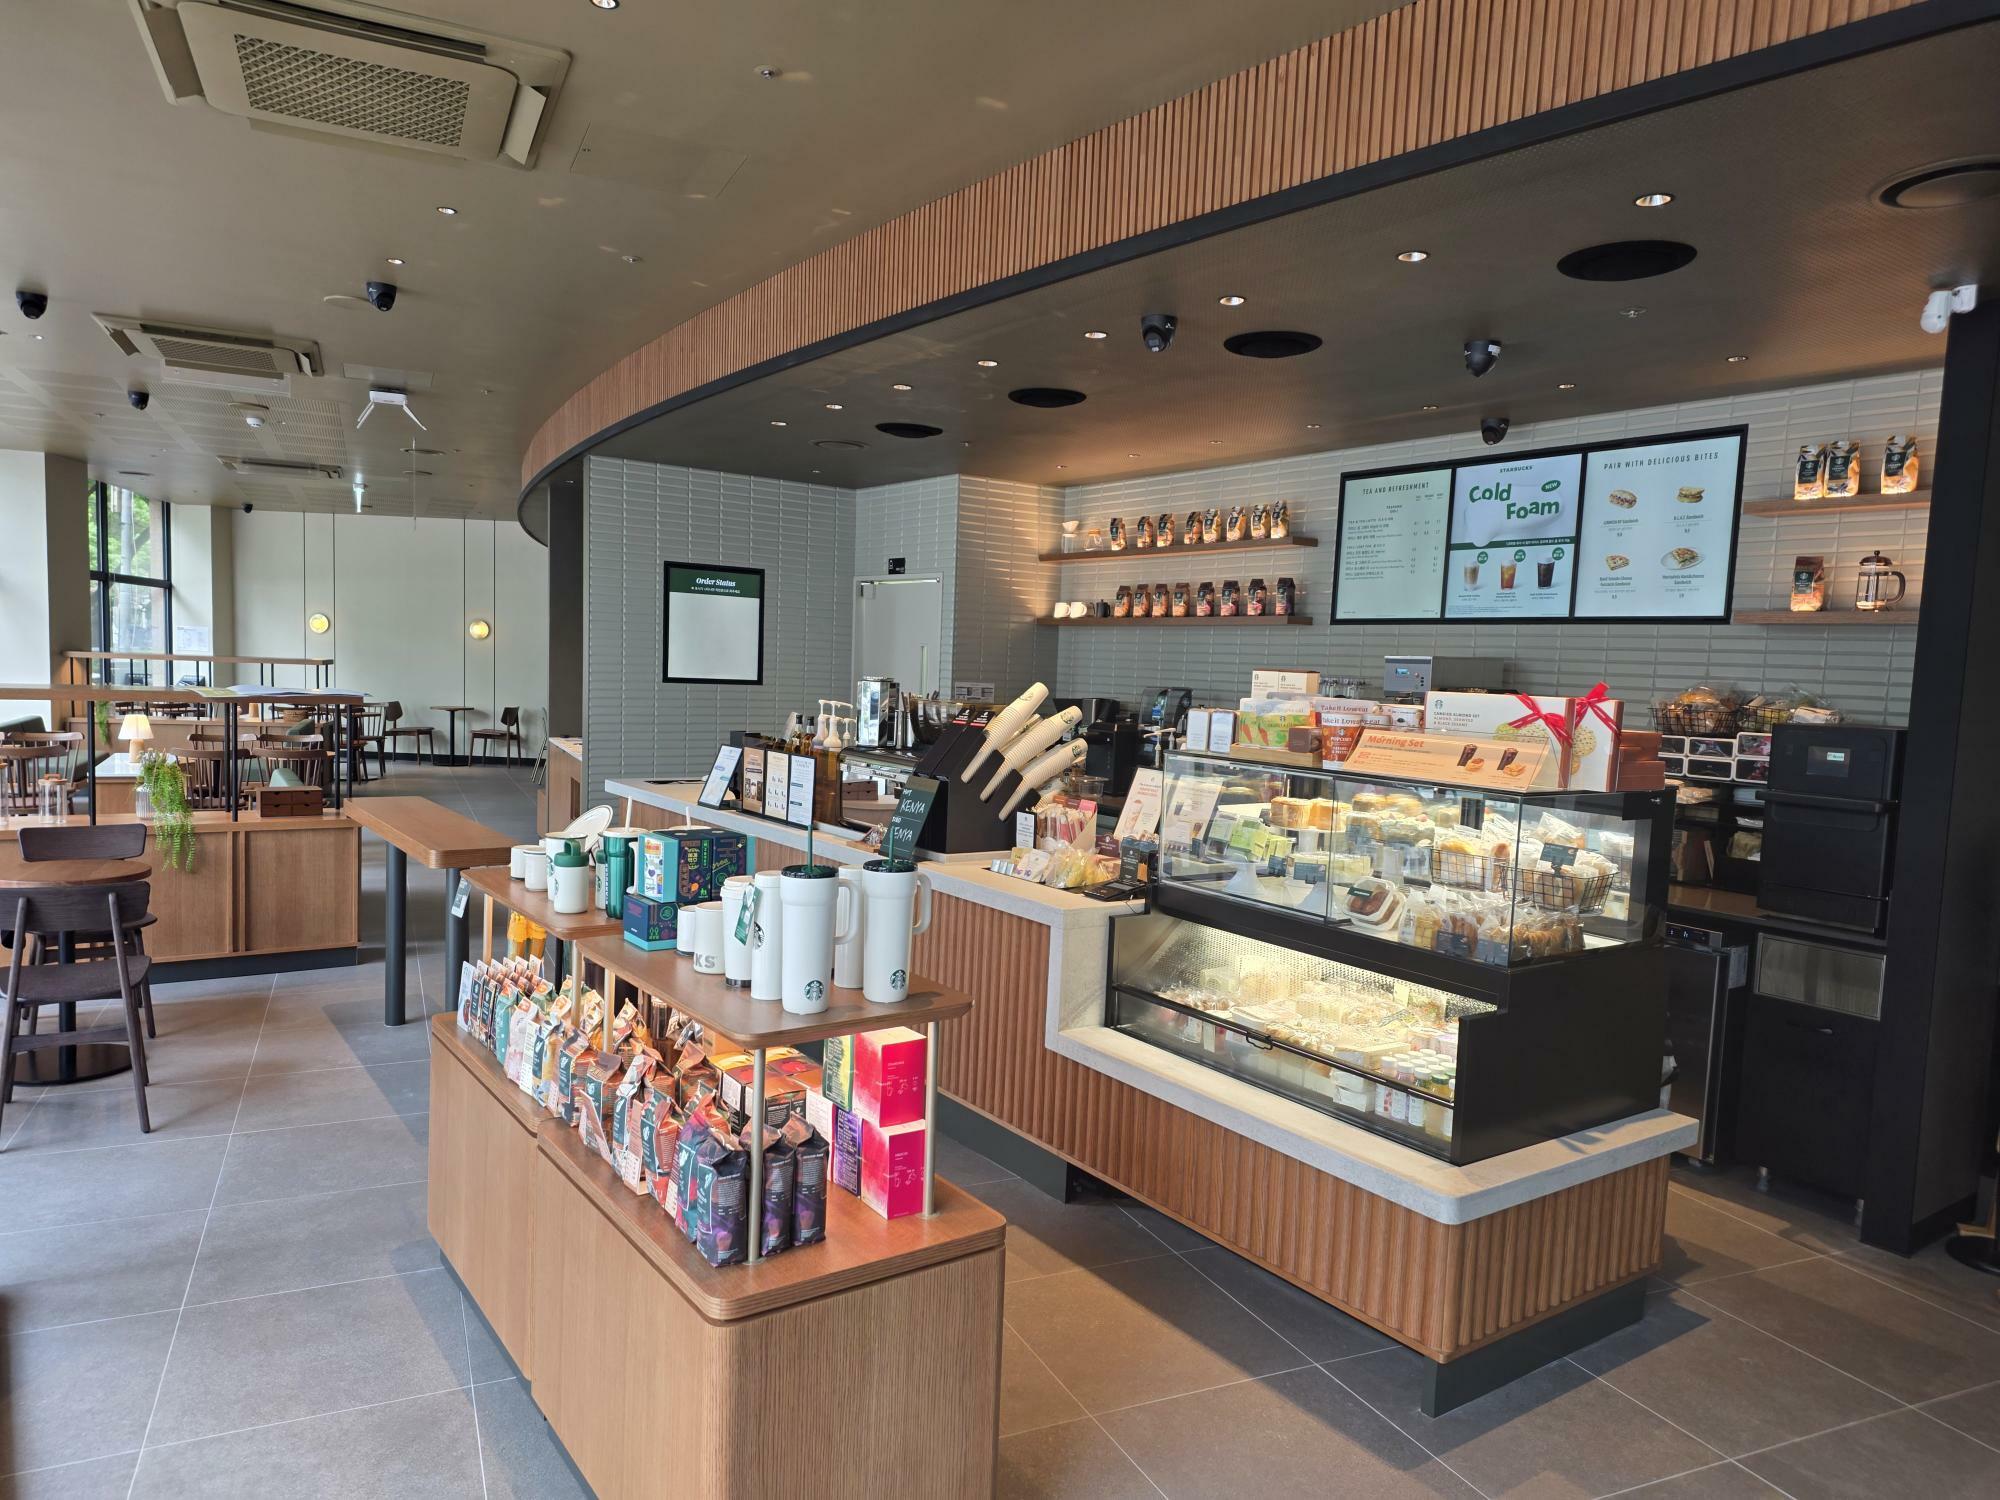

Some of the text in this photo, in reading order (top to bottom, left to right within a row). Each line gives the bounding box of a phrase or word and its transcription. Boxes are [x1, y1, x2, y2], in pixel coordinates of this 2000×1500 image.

[1625, 459, 1644, 468] WITH
[1647, 454, 1691, 466] DELICIOUS
[1694, 452, 1719, 461] BITES
[1500, 465, 1533, 473] STARBUCKS
[1374, 486, 1386, 494] AND
[1388, 482, 1430, 493] REFRESHMENT
[1469, 482, 1512, 503] Cold
[1545, 482, 1558, 490] NEW
[1506, 501, 1560, 520] Foam
[696, 577, 736, 587] Order Status
[1367, 735, 1424, 748] Morning Set
[900, 799, 925, 813] KENYA
[894, 827, 912, 841] ENYA
